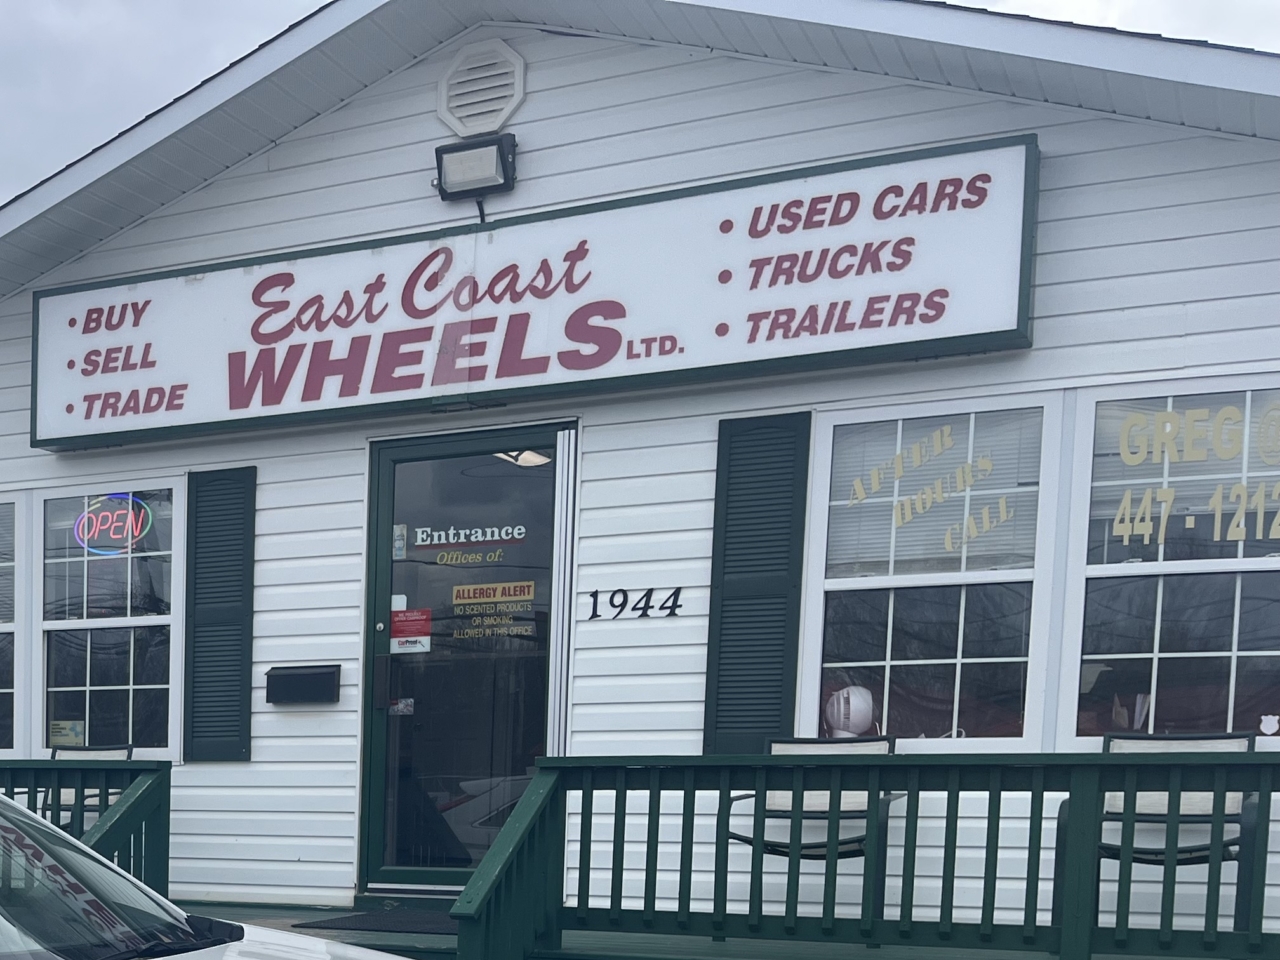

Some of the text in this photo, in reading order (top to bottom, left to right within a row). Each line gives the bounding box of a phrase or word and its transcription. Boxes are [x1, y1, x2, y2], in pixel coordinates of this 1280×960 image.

[747, 173, 992, 239] USED CARS
[746, 237, 917, 291] TRUCKS
[250, 239, 592, 345] East Coast
[82, 300, 152, 334] BUY
[746, 289, 951, 344] TRAILERS
[81, 343, 157, 377] SELL
[227, 299, 685, 411] WHEELS LTD.
[83, 384, 189, 420] TRADE
[1120, 406, 1243, 466] GREG
[847, 424, 955, 508] AFTER
[894, 450, 993, 528] HOURS
[79, 508, 145, 540] OPEN
[415, 525, 526, 545] Entrance
[944, 495, 1015, 551] CALL
[437, 549, 504, 564] Offices of:
[454, 602, 532, 615] NO SCENTED PRODUCTS
[455, 585, 532, 600] ALLERGY ALERT
[589, 587, 683, 620] 1944
[453, 626, 532, 638] ALLOWED IN THIS OFFICE
[472, 615, 513, 626] OR SMOKING
